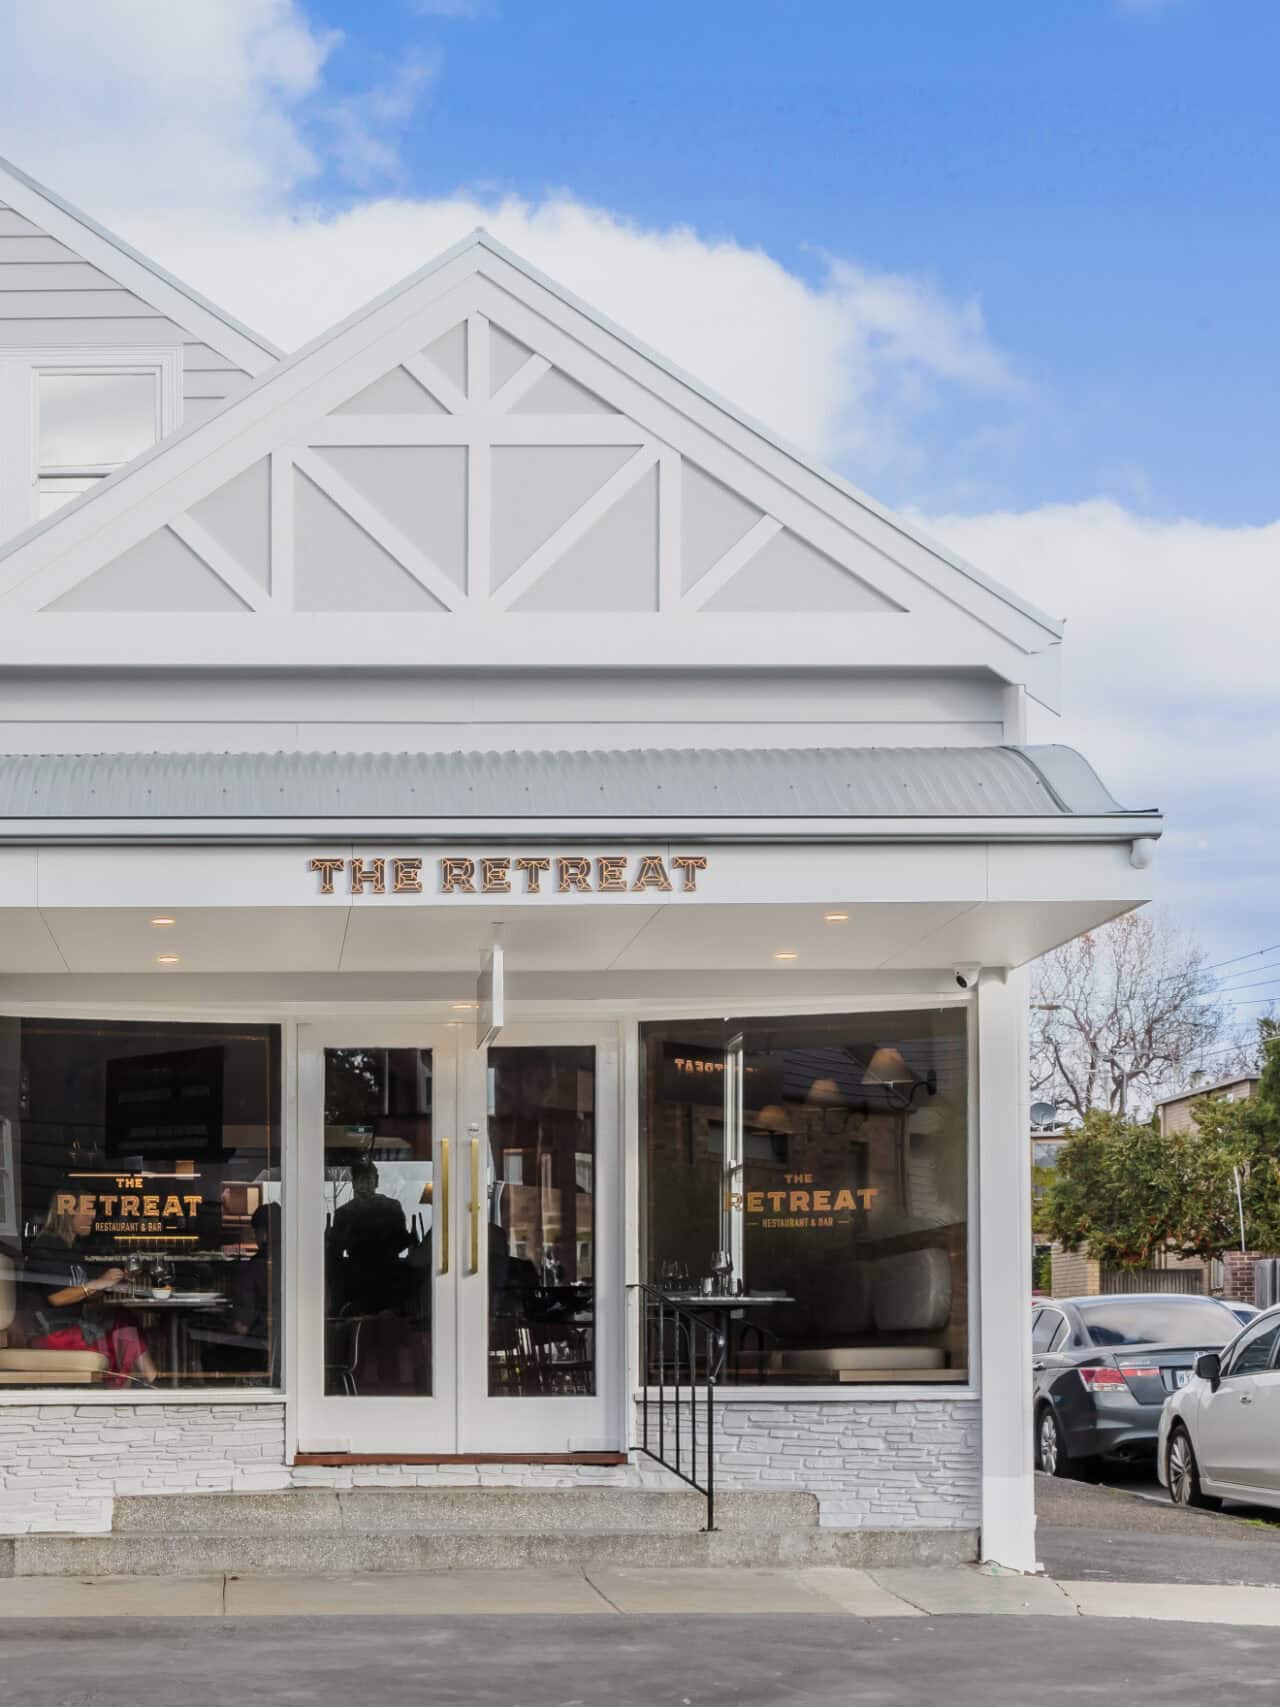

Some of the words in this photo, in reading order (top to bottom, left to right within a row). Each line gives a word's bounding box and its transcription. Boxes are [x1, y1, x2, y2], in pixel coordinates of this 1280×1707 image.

[309, 857, 423, 894] THE
[440, 855, 708, 893] RETREAT
[115, 1178, 144, 1188] THE
[784, 1173, 813, 1184] THE
[56, 1194, 203, 1217] RETREAT
[723, 1188, 879, 1212] RETREAT
[95, 1222, 138, 1232] RESTAURANT
[141, 1222, 146, 1232] &
[148, 1222, 162, 1232] BAR
[762, 1217, 808, 1228] RESTAURANT
[811, 1218, 817, 1227] &
[820, 1217, 833, 1227] BAR
